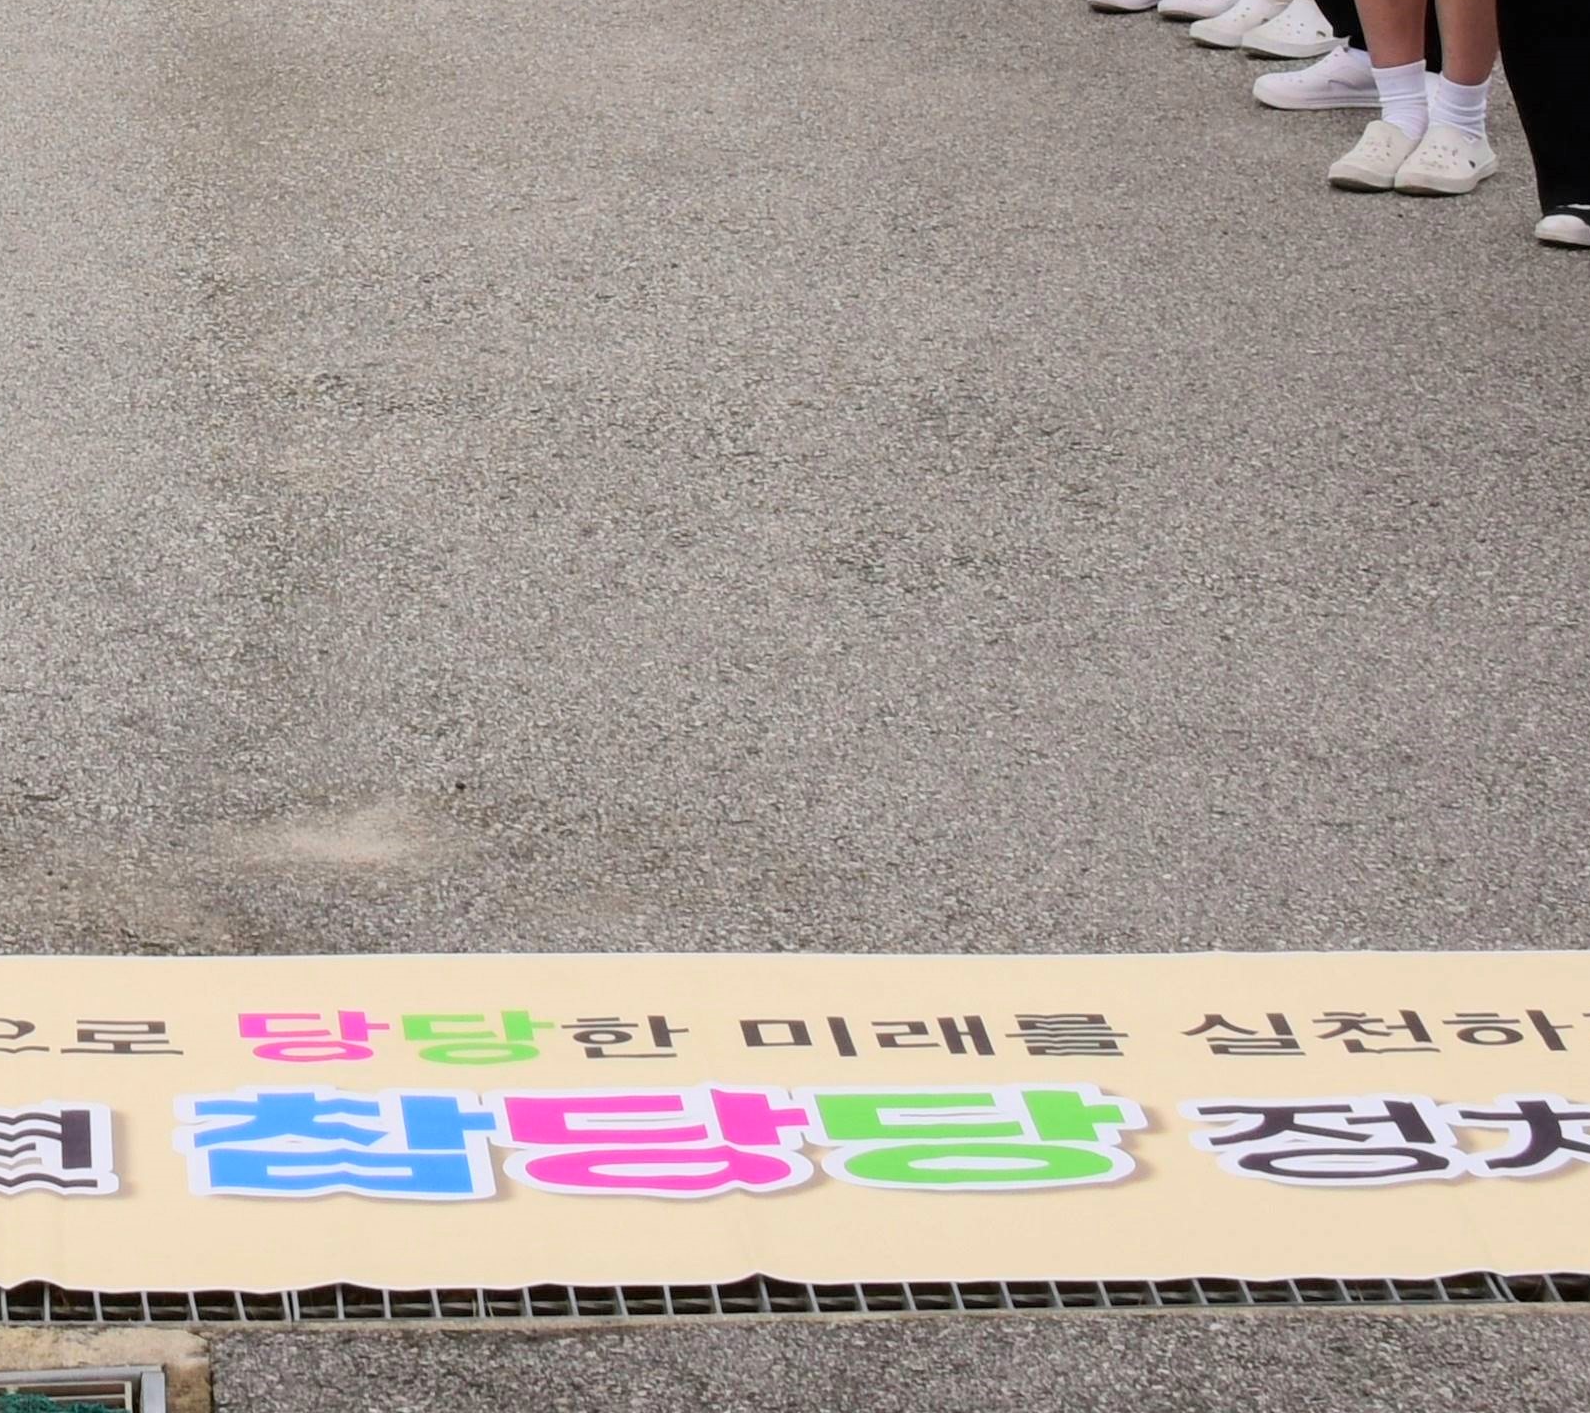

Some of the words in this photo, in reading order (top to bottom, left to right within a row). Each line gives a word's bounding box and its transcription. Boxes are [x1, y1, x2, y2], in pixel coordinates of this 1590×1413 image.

[237, 1009, 689, 1065] 당당한
[738, 1011, 1129, 1058] 미래를
[193, 1085, 1127, 1195] 참당당
